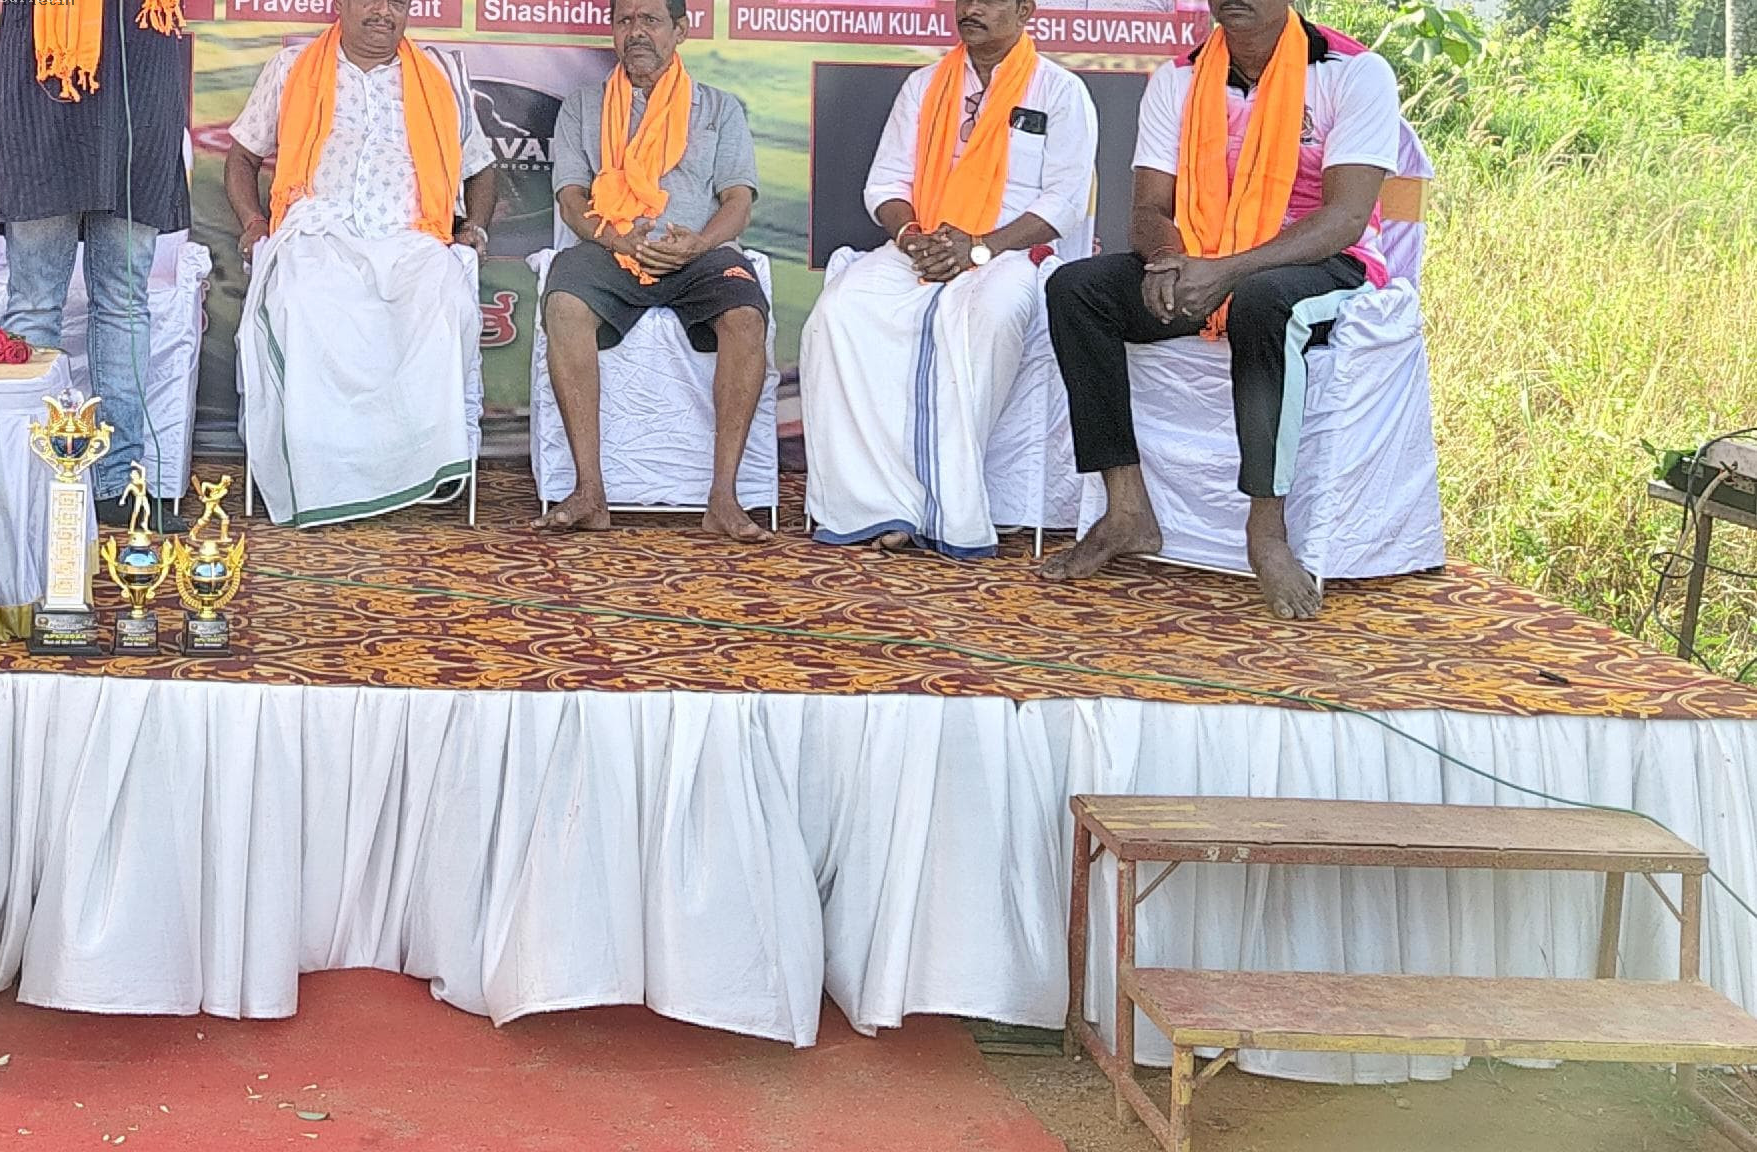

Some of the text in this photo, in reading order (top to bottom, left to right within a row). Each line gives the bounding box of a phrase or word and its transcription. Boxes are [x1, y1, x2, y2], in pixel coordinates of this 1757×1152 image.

[737, 8, 951, 37] PURUSHOTHAM KULAL
[1024, 17, 1195, 45] ESH SUVARNA K
